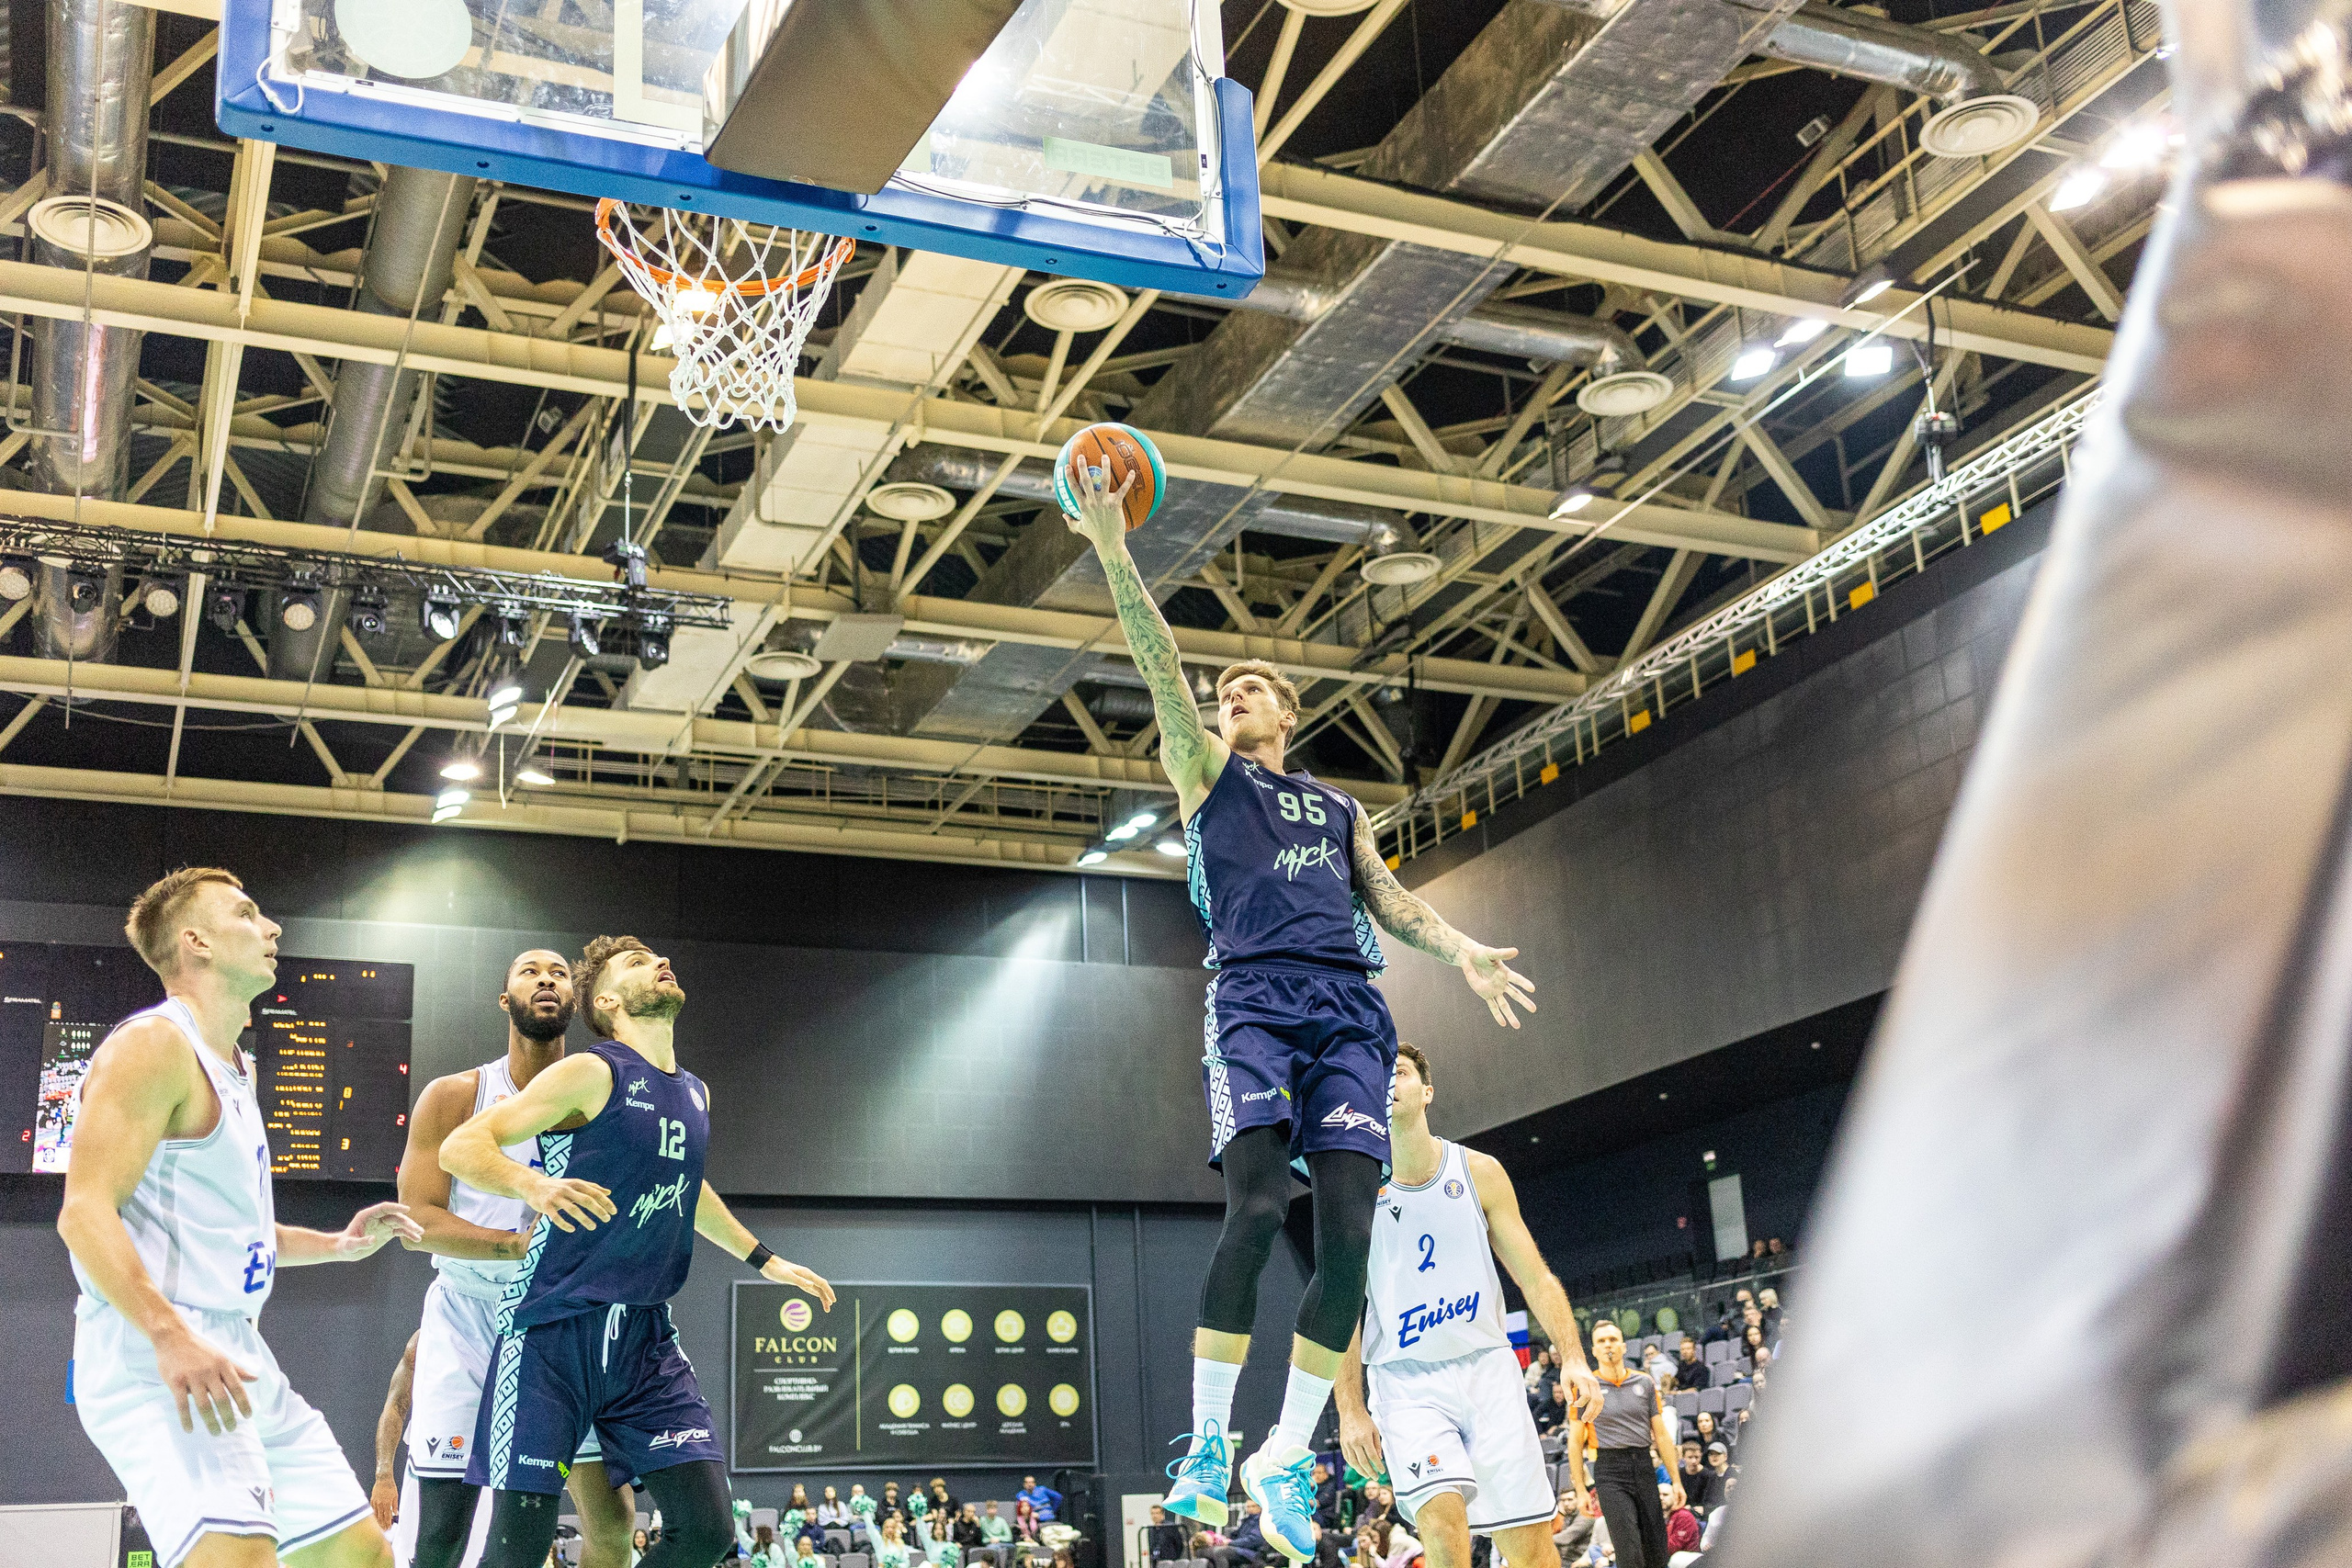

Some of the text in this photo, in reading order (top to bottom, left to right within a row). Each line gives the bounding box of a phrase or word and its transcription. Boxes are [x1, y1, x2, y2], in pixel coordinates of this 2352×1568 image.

[1277, 792, 1327, 826] 95
[399, 1063, 408, 1075] 4
[1241, 1088, 1277, 1103] Kempa
[626, 1098, 655, 1111] Kempa
[397, 1113, 406, 1126] 2
[22, 1130, 30, 1142] 2
[659, 1117, 686, 1161] 12
[341, 1137, 350, 1150] 3
[1418, 1234, 1436, 1273] 2
[1397, 1291, 1480, 1348] Enisey
[754, 1337, 837, 1353] FALCON
[774, 1356, 818, 1364] CLUB
[518, 1454, 555, 1468] Kempa
